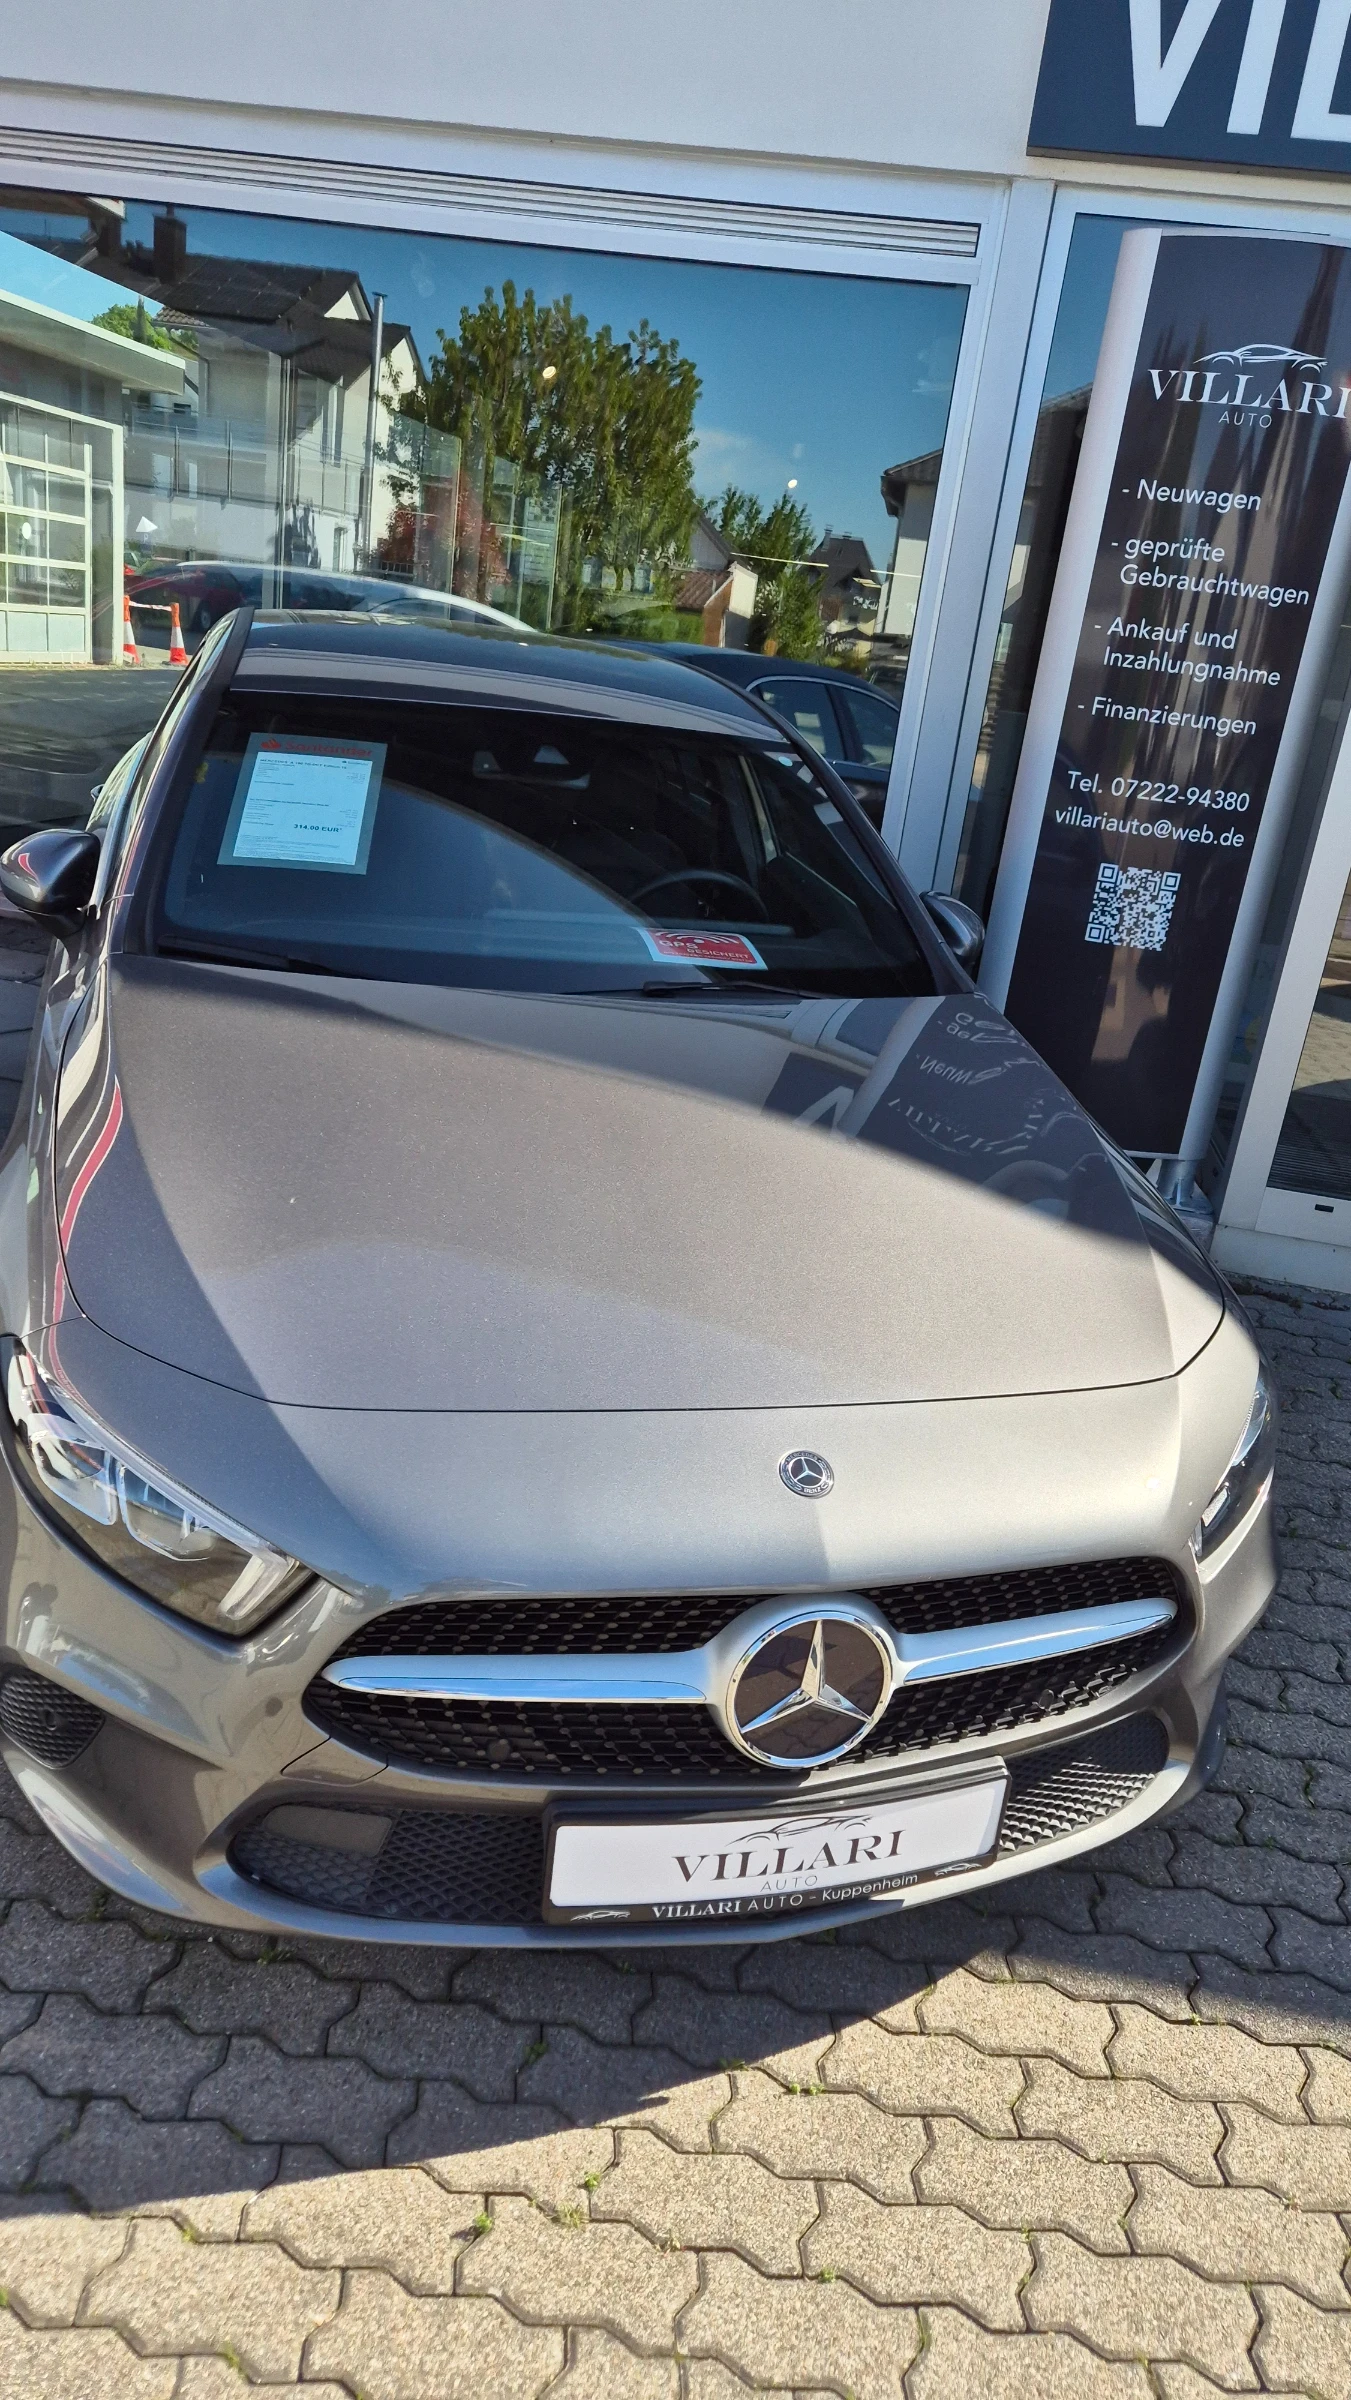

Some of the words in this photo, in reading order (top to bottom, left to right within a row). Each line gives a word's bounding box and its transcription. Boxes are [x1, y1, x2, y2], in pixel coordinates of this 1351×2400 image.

[1148, 369, 1351, 419] VILLARI
[1218, 411, 1273, 429] AUTO
[1137, 478, 1262, 514] Neuwagen
[1124, 537, 1225, 563] geprüfte
[1120, 564, 1309, 607] Gebrauchtwagen
[1107, 616, 1190, 643] Ankauf
[1194, 628, 1238, 649] und
[1103, 646, 1281, 686] Inzahlungnahme
[1091, 696, 1257, 737] Finanzierungen
[1067, 771, 1103, 794] Tel.
[1111, 777, 1250, 812] 07222-94380
[1055, 806, 1245, 847] villariauto@web.de
[659, 940, 698, 949] GPS
[687, 948, 749, 959] GESICHERT
[673, 1829, 906, 1883] VILLARI
[652, 1901, 741, 1919] VILLARI
[748, 1894, 803, 1911] AUTO
[822, 1874, 918, 1901] Kuppenheim
[760, 1875, 818, 1892] AUTO
